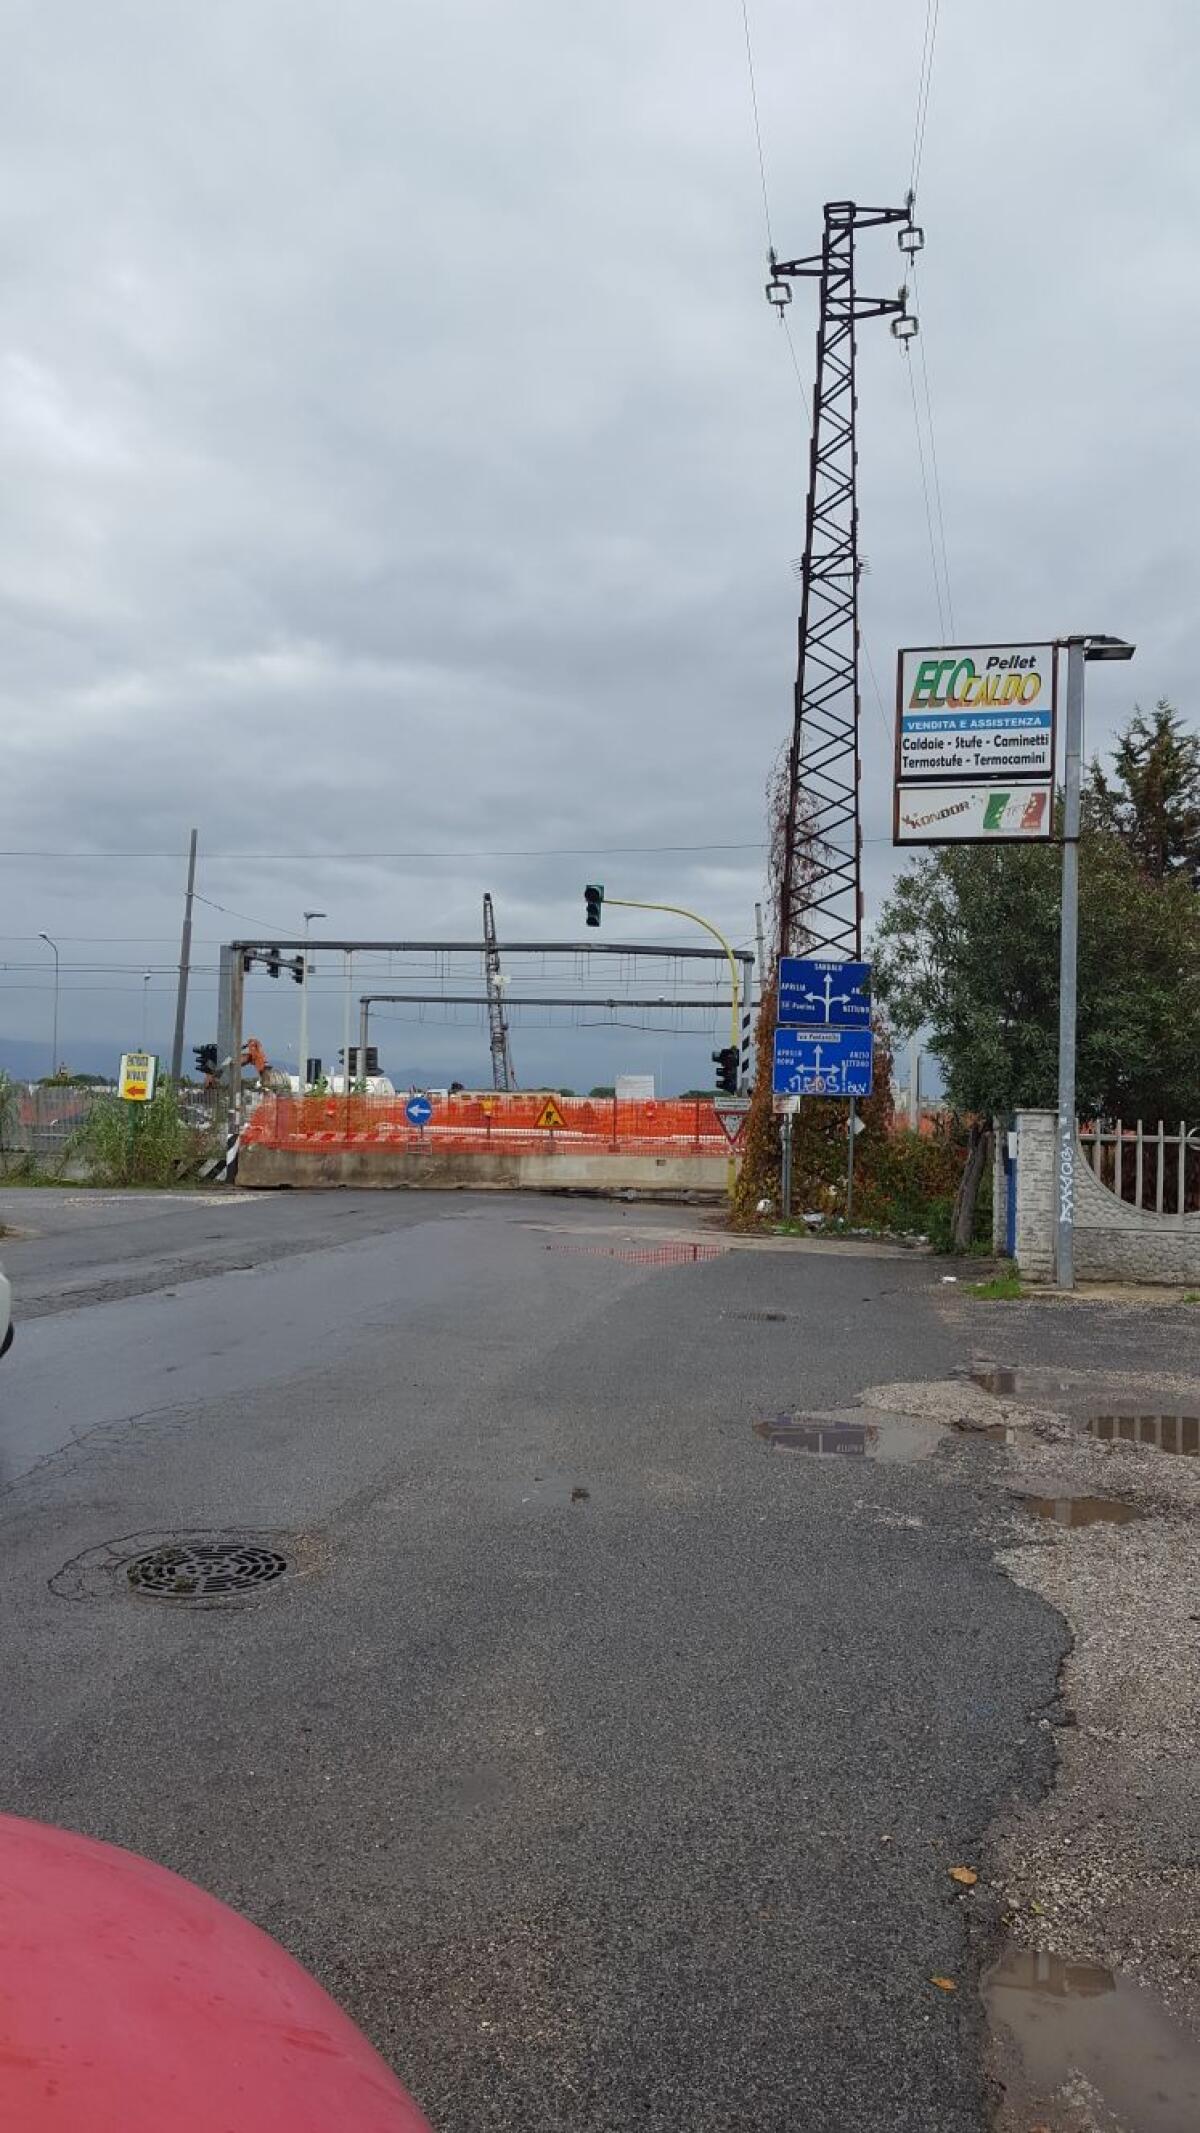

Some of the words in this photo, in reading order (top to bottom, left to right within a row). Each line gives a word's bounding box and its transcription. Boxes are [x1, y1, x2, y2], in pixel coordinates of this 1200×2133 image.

[986, 655, 1037, 670] Pellet
[907, 719, 957, 731] VENDITA
[960, 719, 967, 729] E
[970, 717, 1042, 728] ASSISTENZA
[902, 736, 944, 751] Caldaie
[955, 735, 983, 749] Stufe
[993, 733, 1049, 748] Caminetti
[902, 754, 963, 768] Termostufe
[973, 751, 1045, 766] Termocamini
[781, 982, 806, 991] APRILIA
